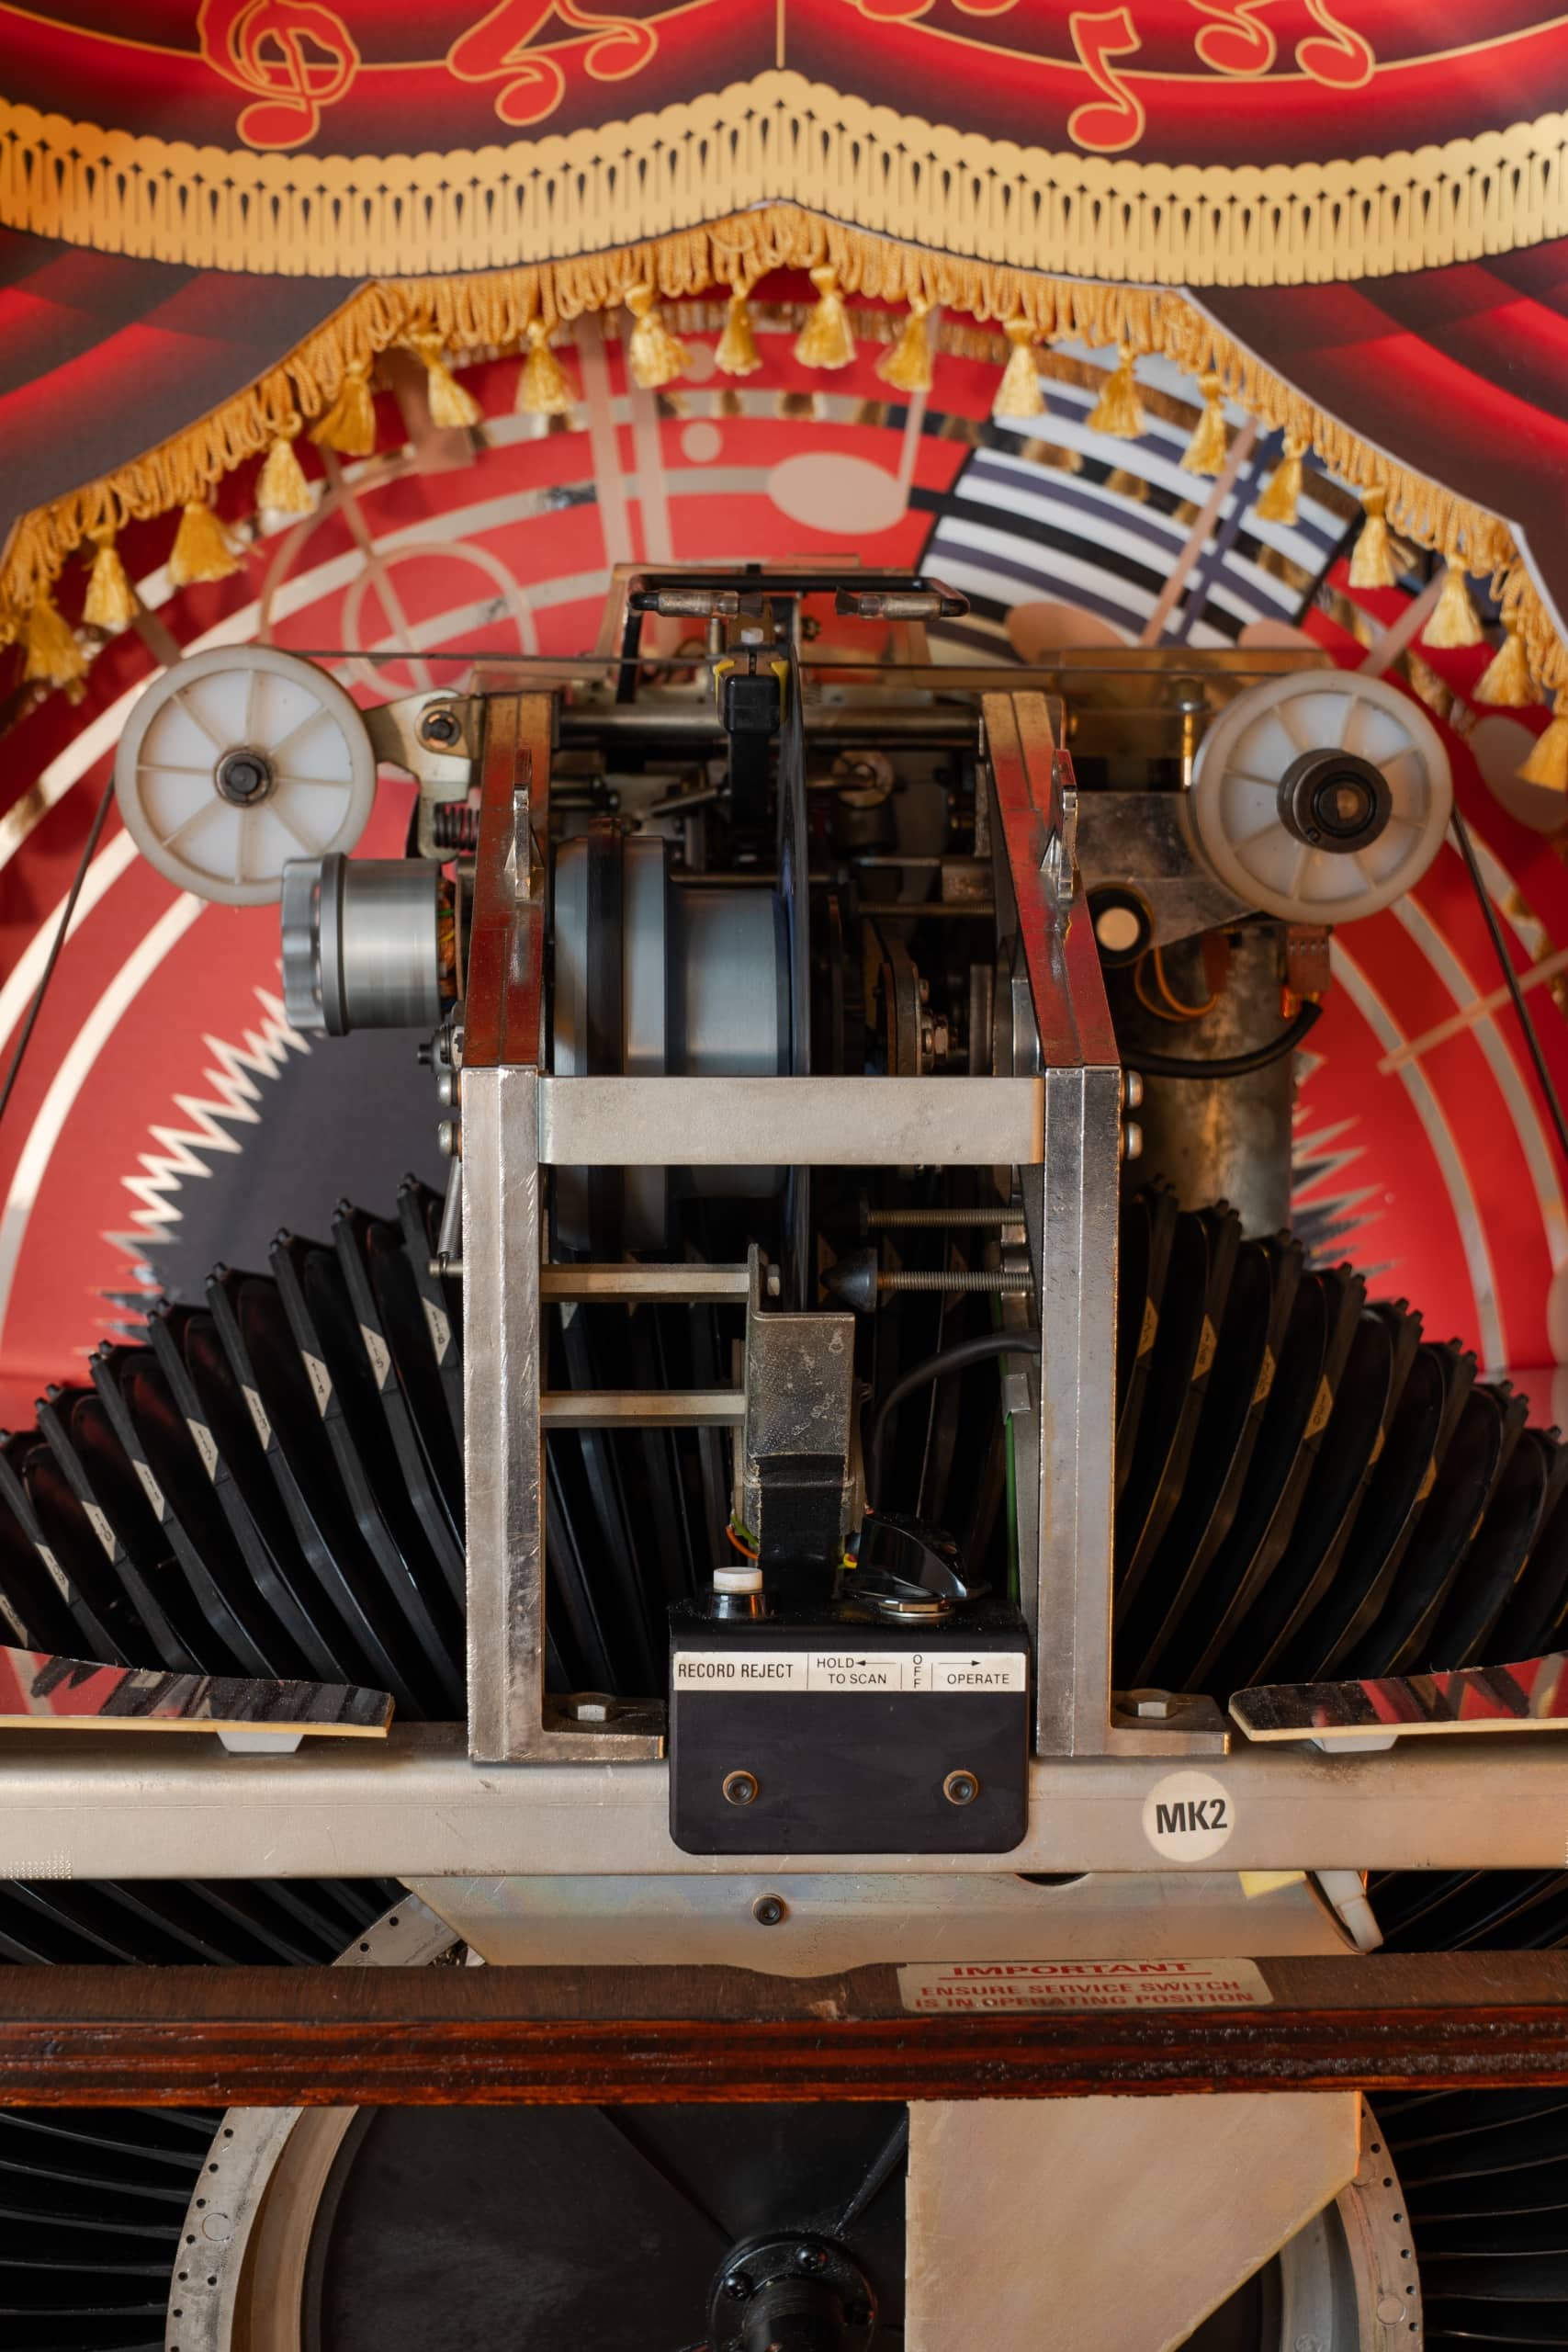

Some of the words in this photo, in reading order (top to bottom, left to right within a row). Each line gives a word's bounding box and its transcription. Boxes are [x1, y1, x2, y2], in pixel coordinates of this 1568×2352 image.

[95, 1513, 112, 1542] 110
[817, 1658, 855, 1668] HOLD
[678, 1663, 735, 1678] RECORD
[741, 1663, 794, 1678] REJECT
[913, 1655, 923, 1689] OFF
[829, 1674, 846, 1684] TO
[850, 1674, 887, 1684] SCAN
[947, 1674, 1010, 1684] OPERATE
[1156, 1799, 1228, 1834] MK2
[953, 1962, 1191, 1976] IMPORTANT
[921, 1984, 1021, 1996] ENSURE
[1028, 1983, 1133, 1995] SERVICE
[1140, 1981, 1240, 1992] SWITCH
[915, 1998, 939, 2007] IS
[948, 1997, 974, 2007] IN
[981, 1995, 1127, 2007] OPERATING
[1134, 1993, 1255, 2004] POSITION
